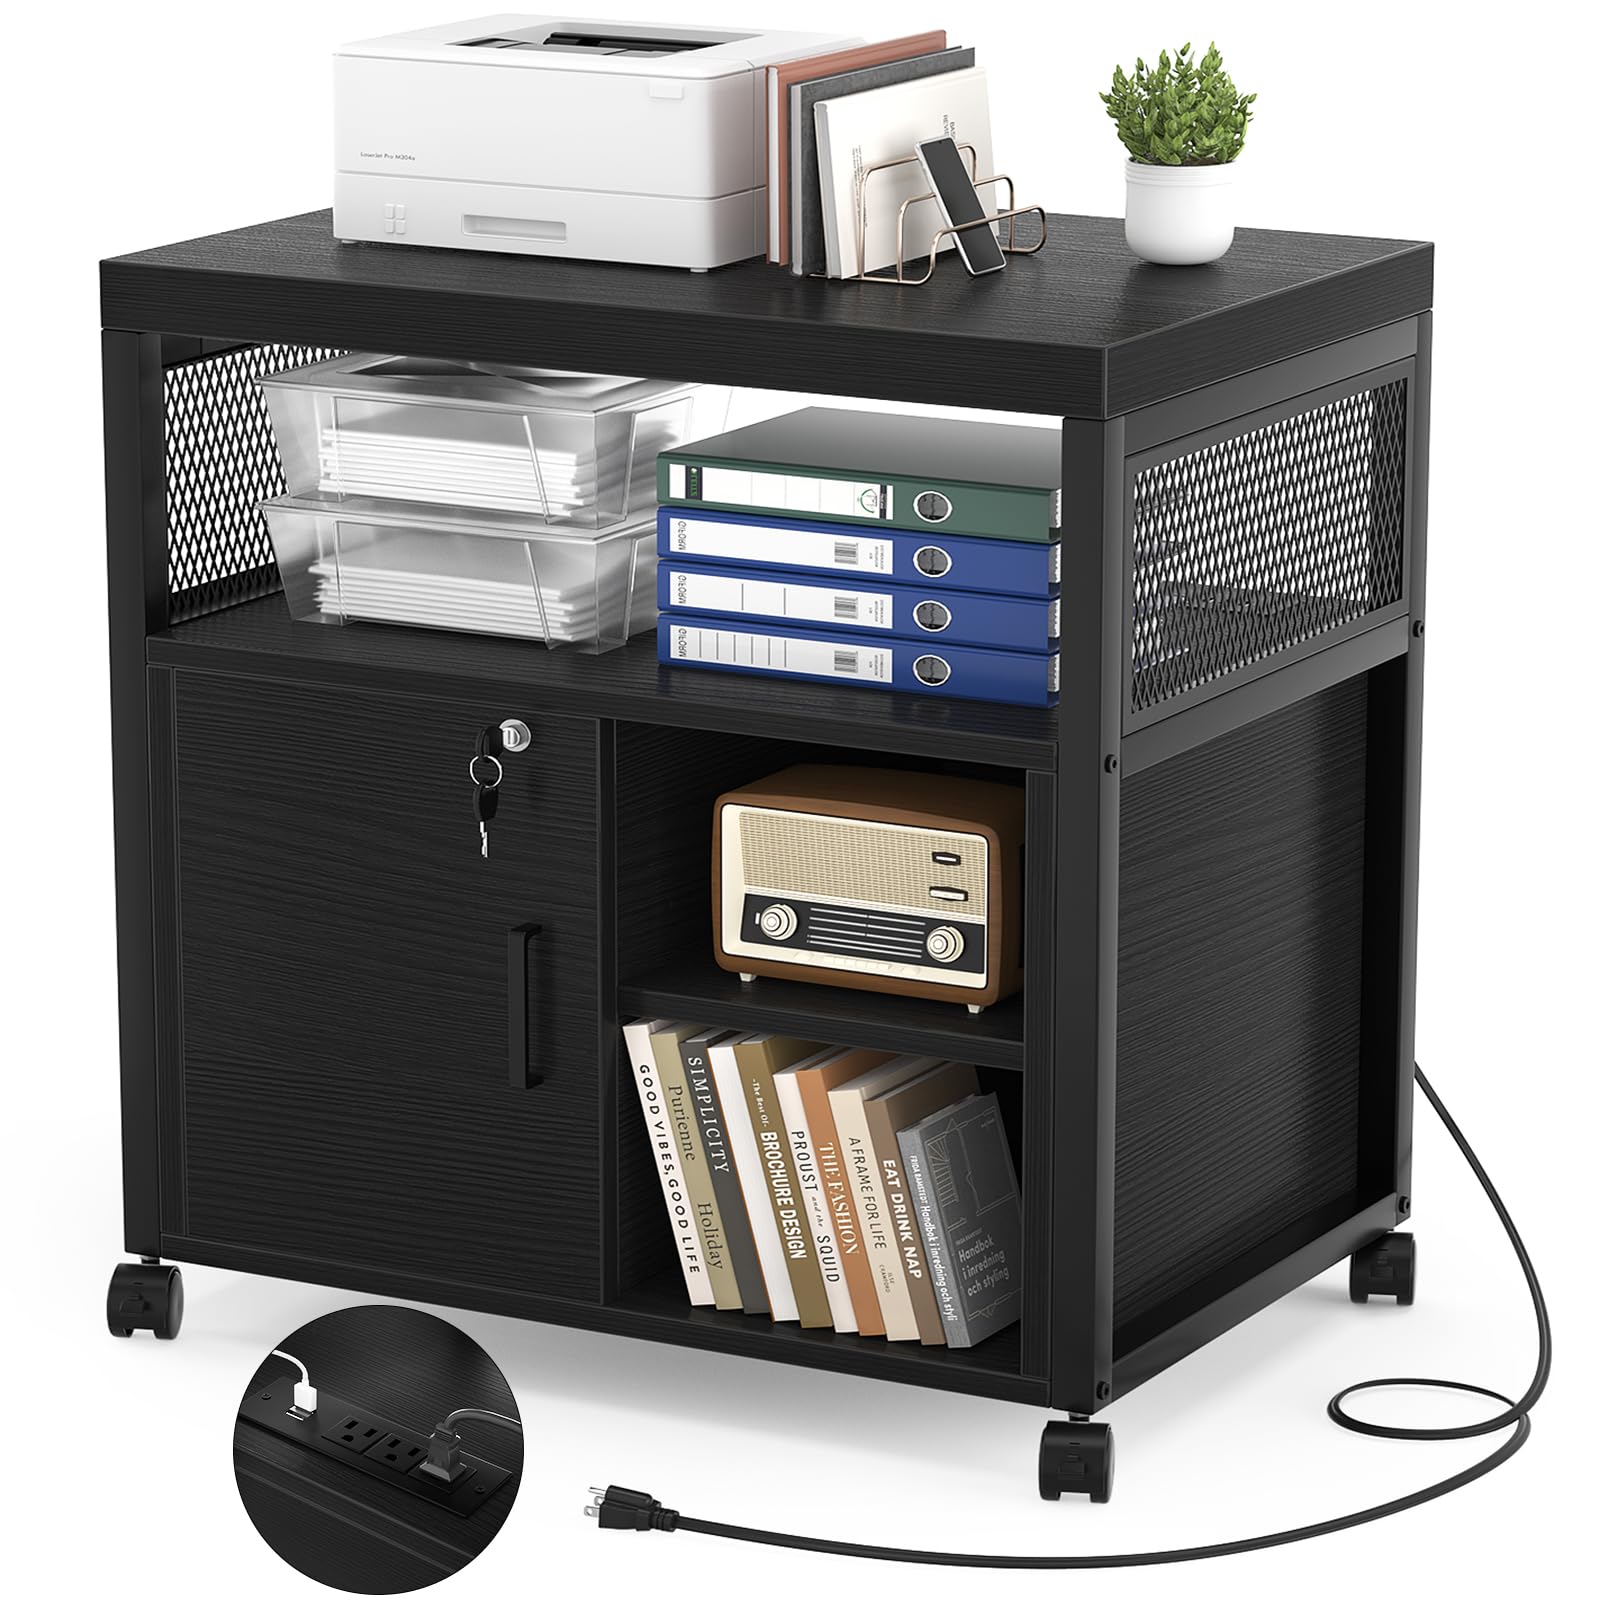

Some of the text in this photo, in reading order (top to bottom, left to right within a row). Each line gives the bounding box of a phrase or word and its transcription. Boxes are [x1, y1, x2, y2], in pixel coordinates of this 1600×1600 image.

[687, 1057, 730, 1173] SIMPLICITY
[756, 1097, 765, 1113] Best
[640, 1064, 660, 1115] GOOD
[668, 1178, 689, 1229] GOOD
[682, 1236, 701, 1273] LIFE
[668, 1085, 723, 1270] Purienne Holiday
[760, 1131, 807, 1260] BROCHURE DESIGN
[791, 1131, 840, 1283] PROUST and the SQUID
[819, 1142, 859, 1255] THE FASHION
[848, 1137, 888, 1249] A FRAME FOR LIFE
[883, 1159, 922, 1279] EAT DRINK NAP
[920, 1204, 939, 1242] Handbok
[930, 1247, 948, 1287] inredning
[940, 1286, 952, 1303] och
[958, 1234, 995, 1263] Handbok
[962, 1250, 1006, 1280] i inredning
[967, 1266, 1010, 1297] och styling
